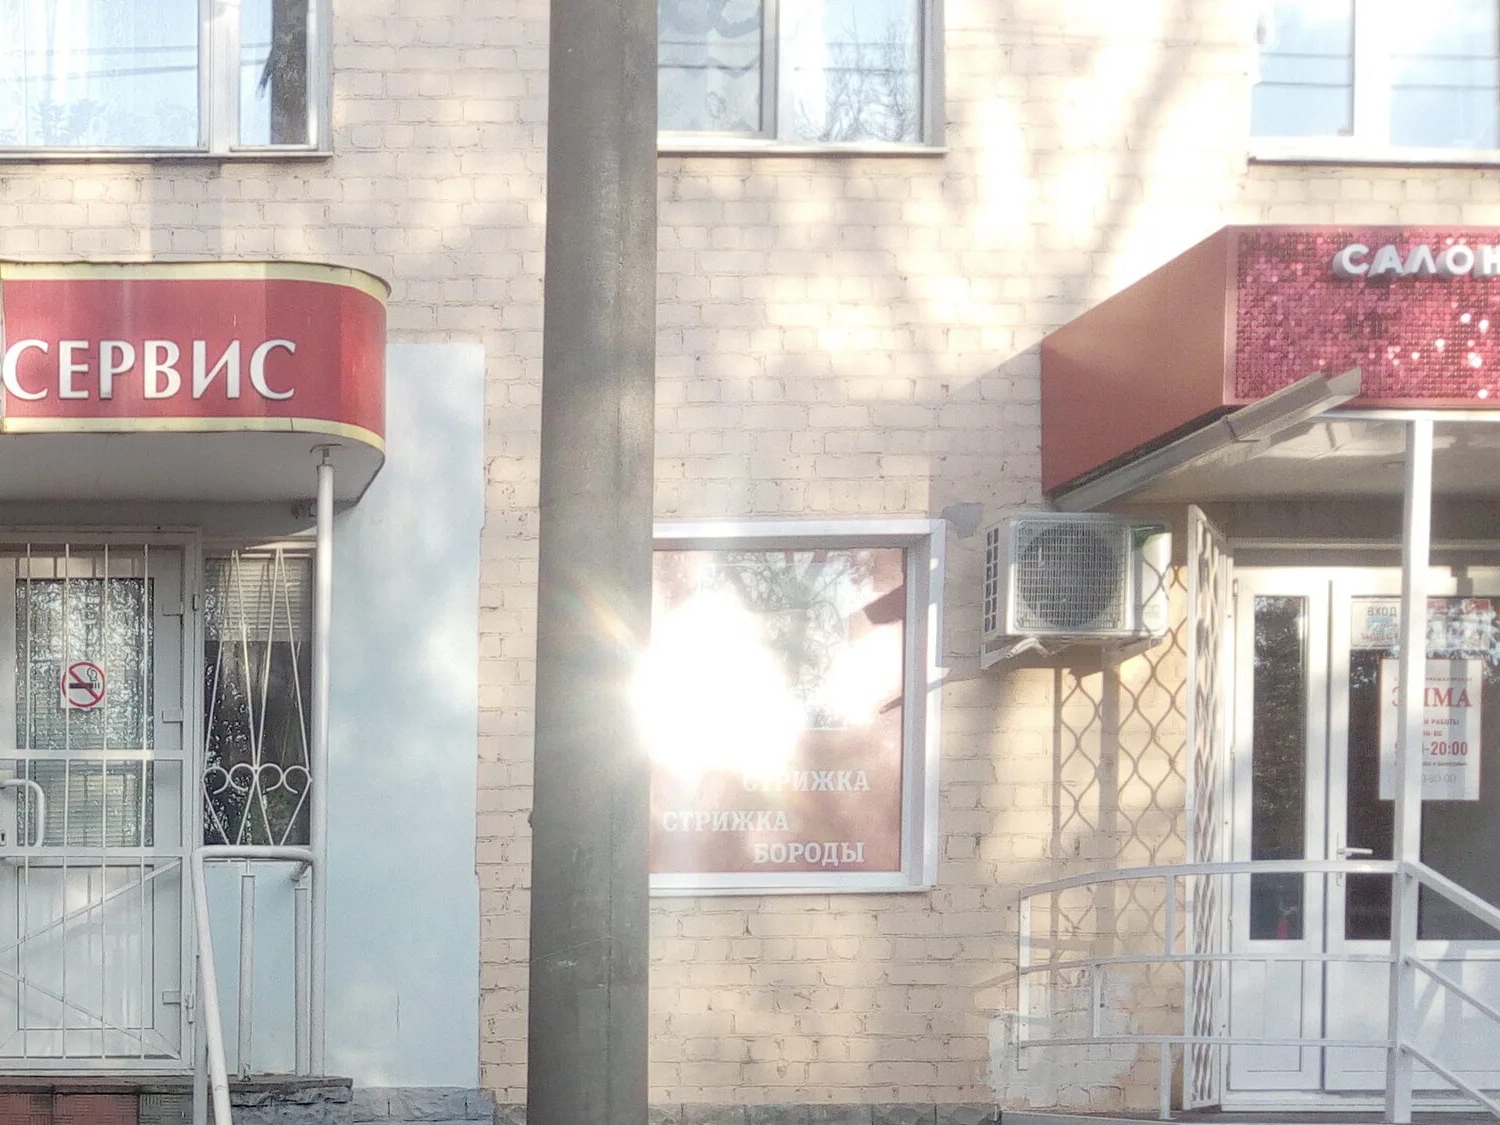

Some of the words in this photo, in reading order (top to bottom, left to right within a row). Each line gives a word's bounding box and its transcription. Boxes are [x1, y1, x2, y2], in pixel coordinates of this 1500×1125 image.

[1367, 605, 1398, 617] ВХОД
[663, 810, 790, 833] СТРИЖКА
[752, 842, 866, 867] БОРОДЫ
